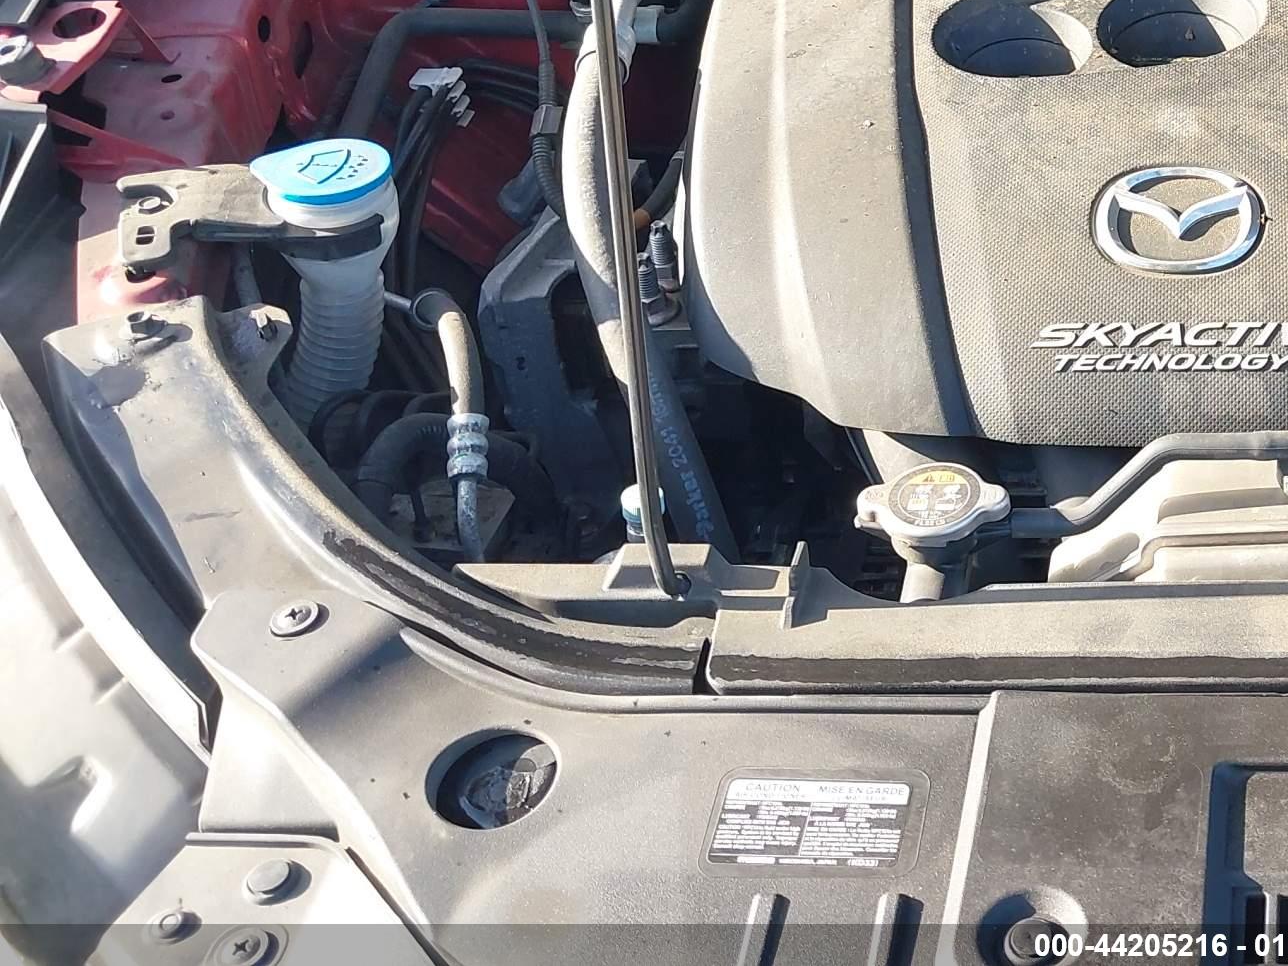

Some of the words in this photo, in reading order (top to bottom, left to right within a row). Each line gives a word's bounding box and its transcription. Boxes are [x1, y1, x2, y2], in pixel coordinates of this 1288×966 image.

[745, 783, 801, 793] CAUTION
[818, 785, 845, 794] MISE
[848, 786, 863, 794] EN
[865, 787, 905, 796] GARDE
